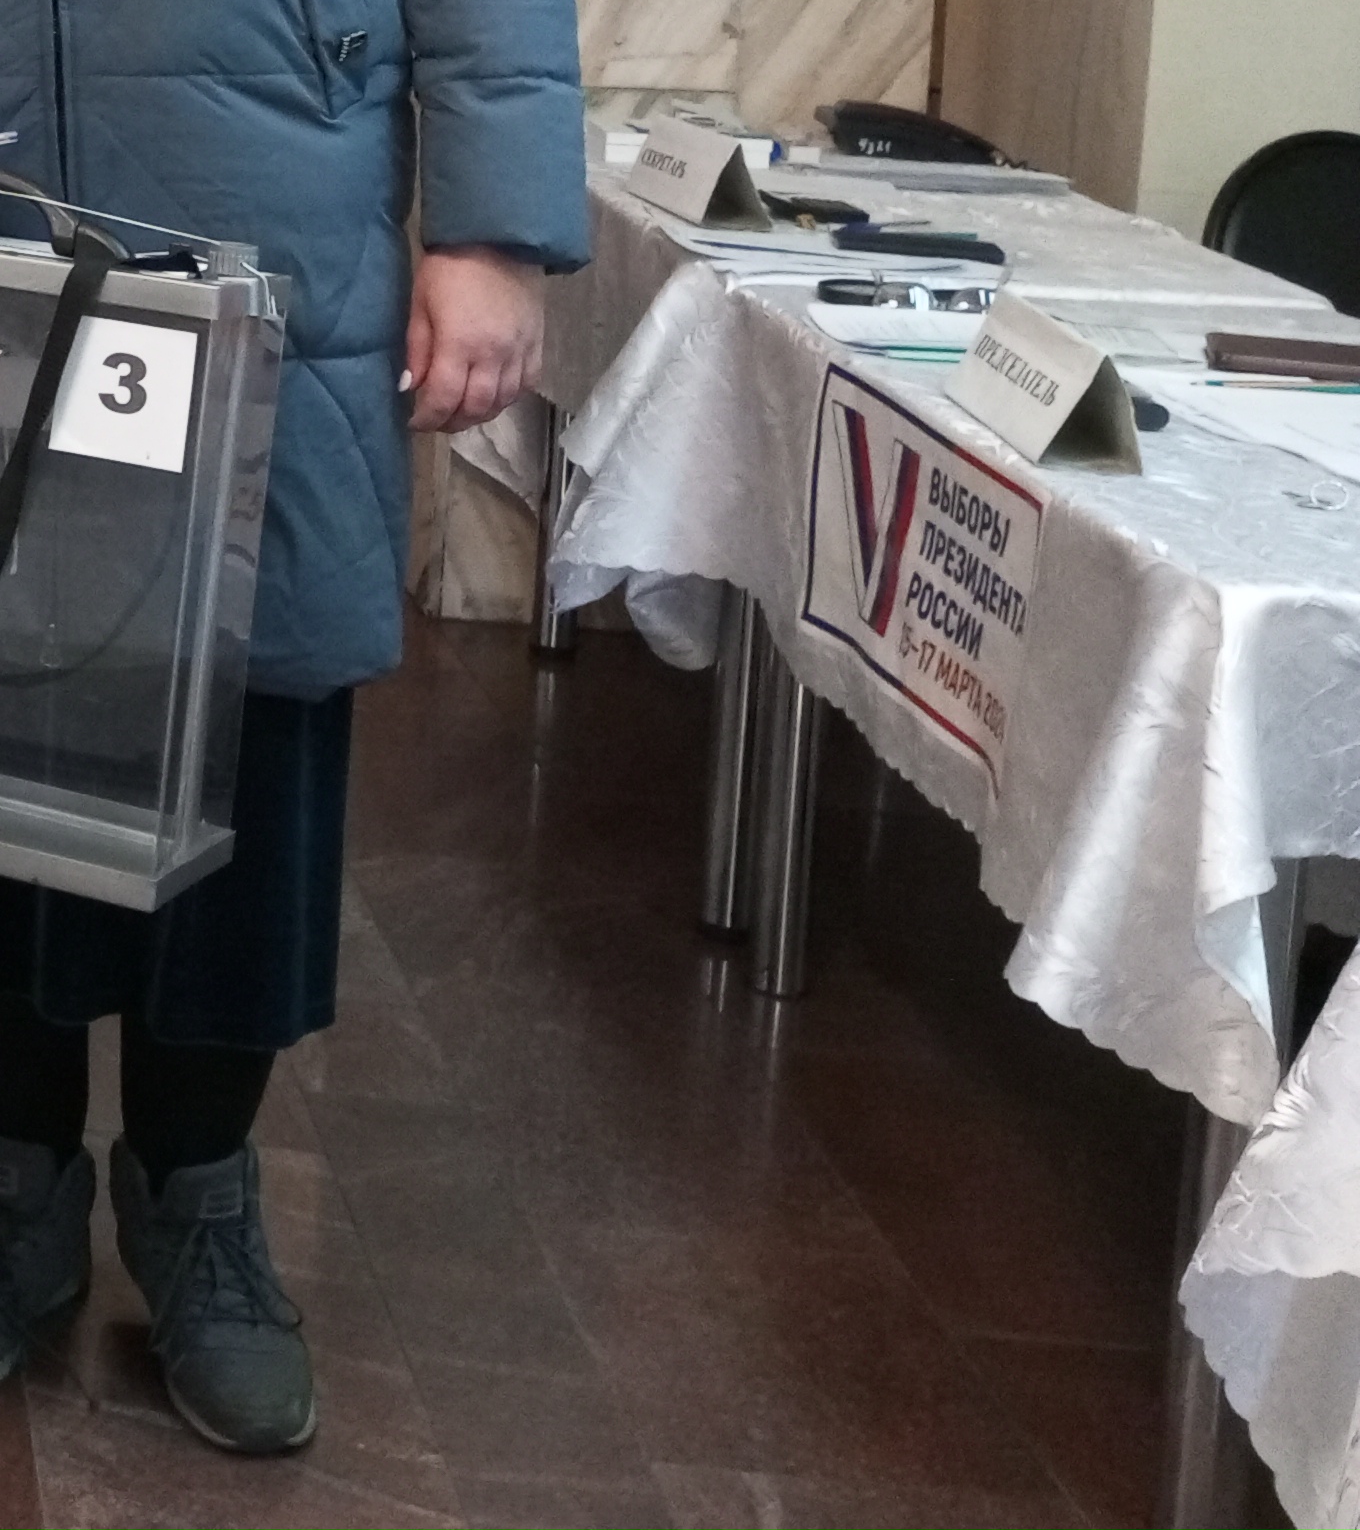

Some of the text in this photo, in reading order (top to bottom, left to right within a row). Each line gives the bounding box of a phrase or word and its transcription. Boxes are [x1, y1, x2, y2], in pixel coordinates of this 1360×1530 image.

[97, 352, 148, 414] 3
[973, 334, 1060, 406] ПРЕДСЕДАТЕЛЬ
[927, 466, 1012, 558] ВЫБОРЫ
[904, 570, 985, 662] РОССИИ
[918, 520, 1028, 638] ПРЕЗИДЕНТА
[933, 649, 983, 721] МАРТА
